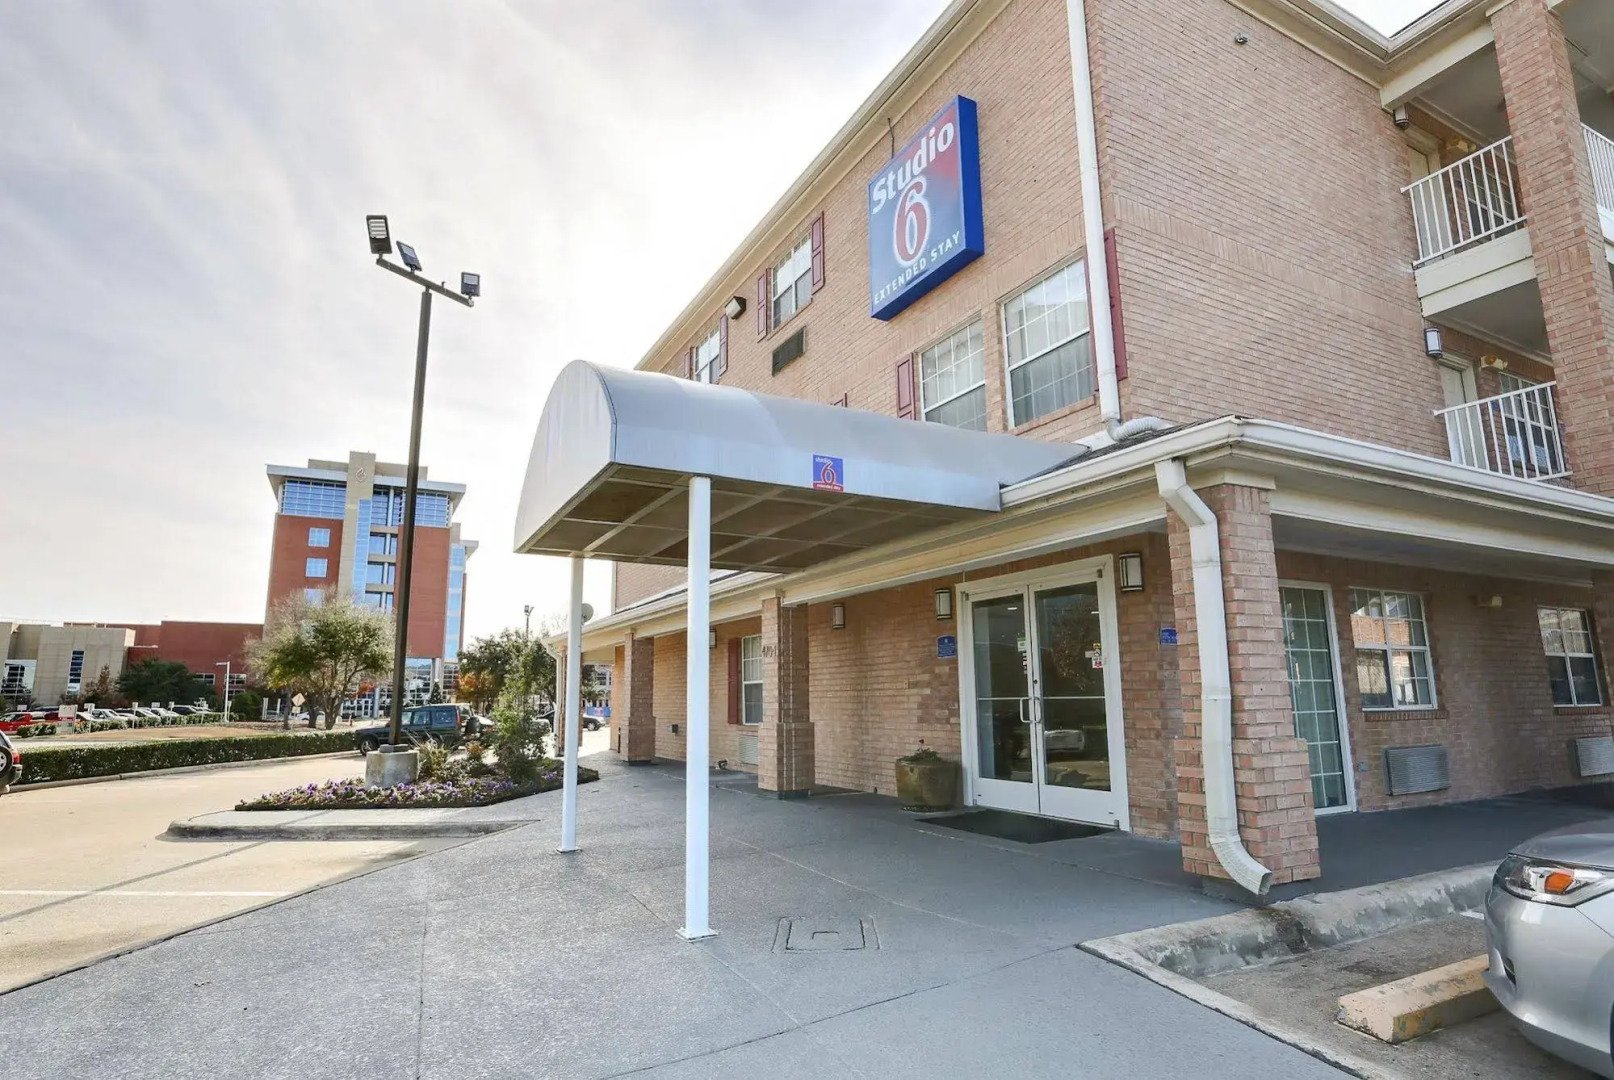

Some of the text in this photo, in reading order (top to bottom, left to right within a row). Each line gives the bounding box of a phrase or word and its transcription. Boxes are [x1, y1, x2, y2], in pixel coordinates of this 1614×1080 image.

[872, 122, 954, 215] Studio
[893, 174, 931, 267] 6
[873, 230, 961, 305] EXTENDED STAY
[821, 460, 836, 485] 6
